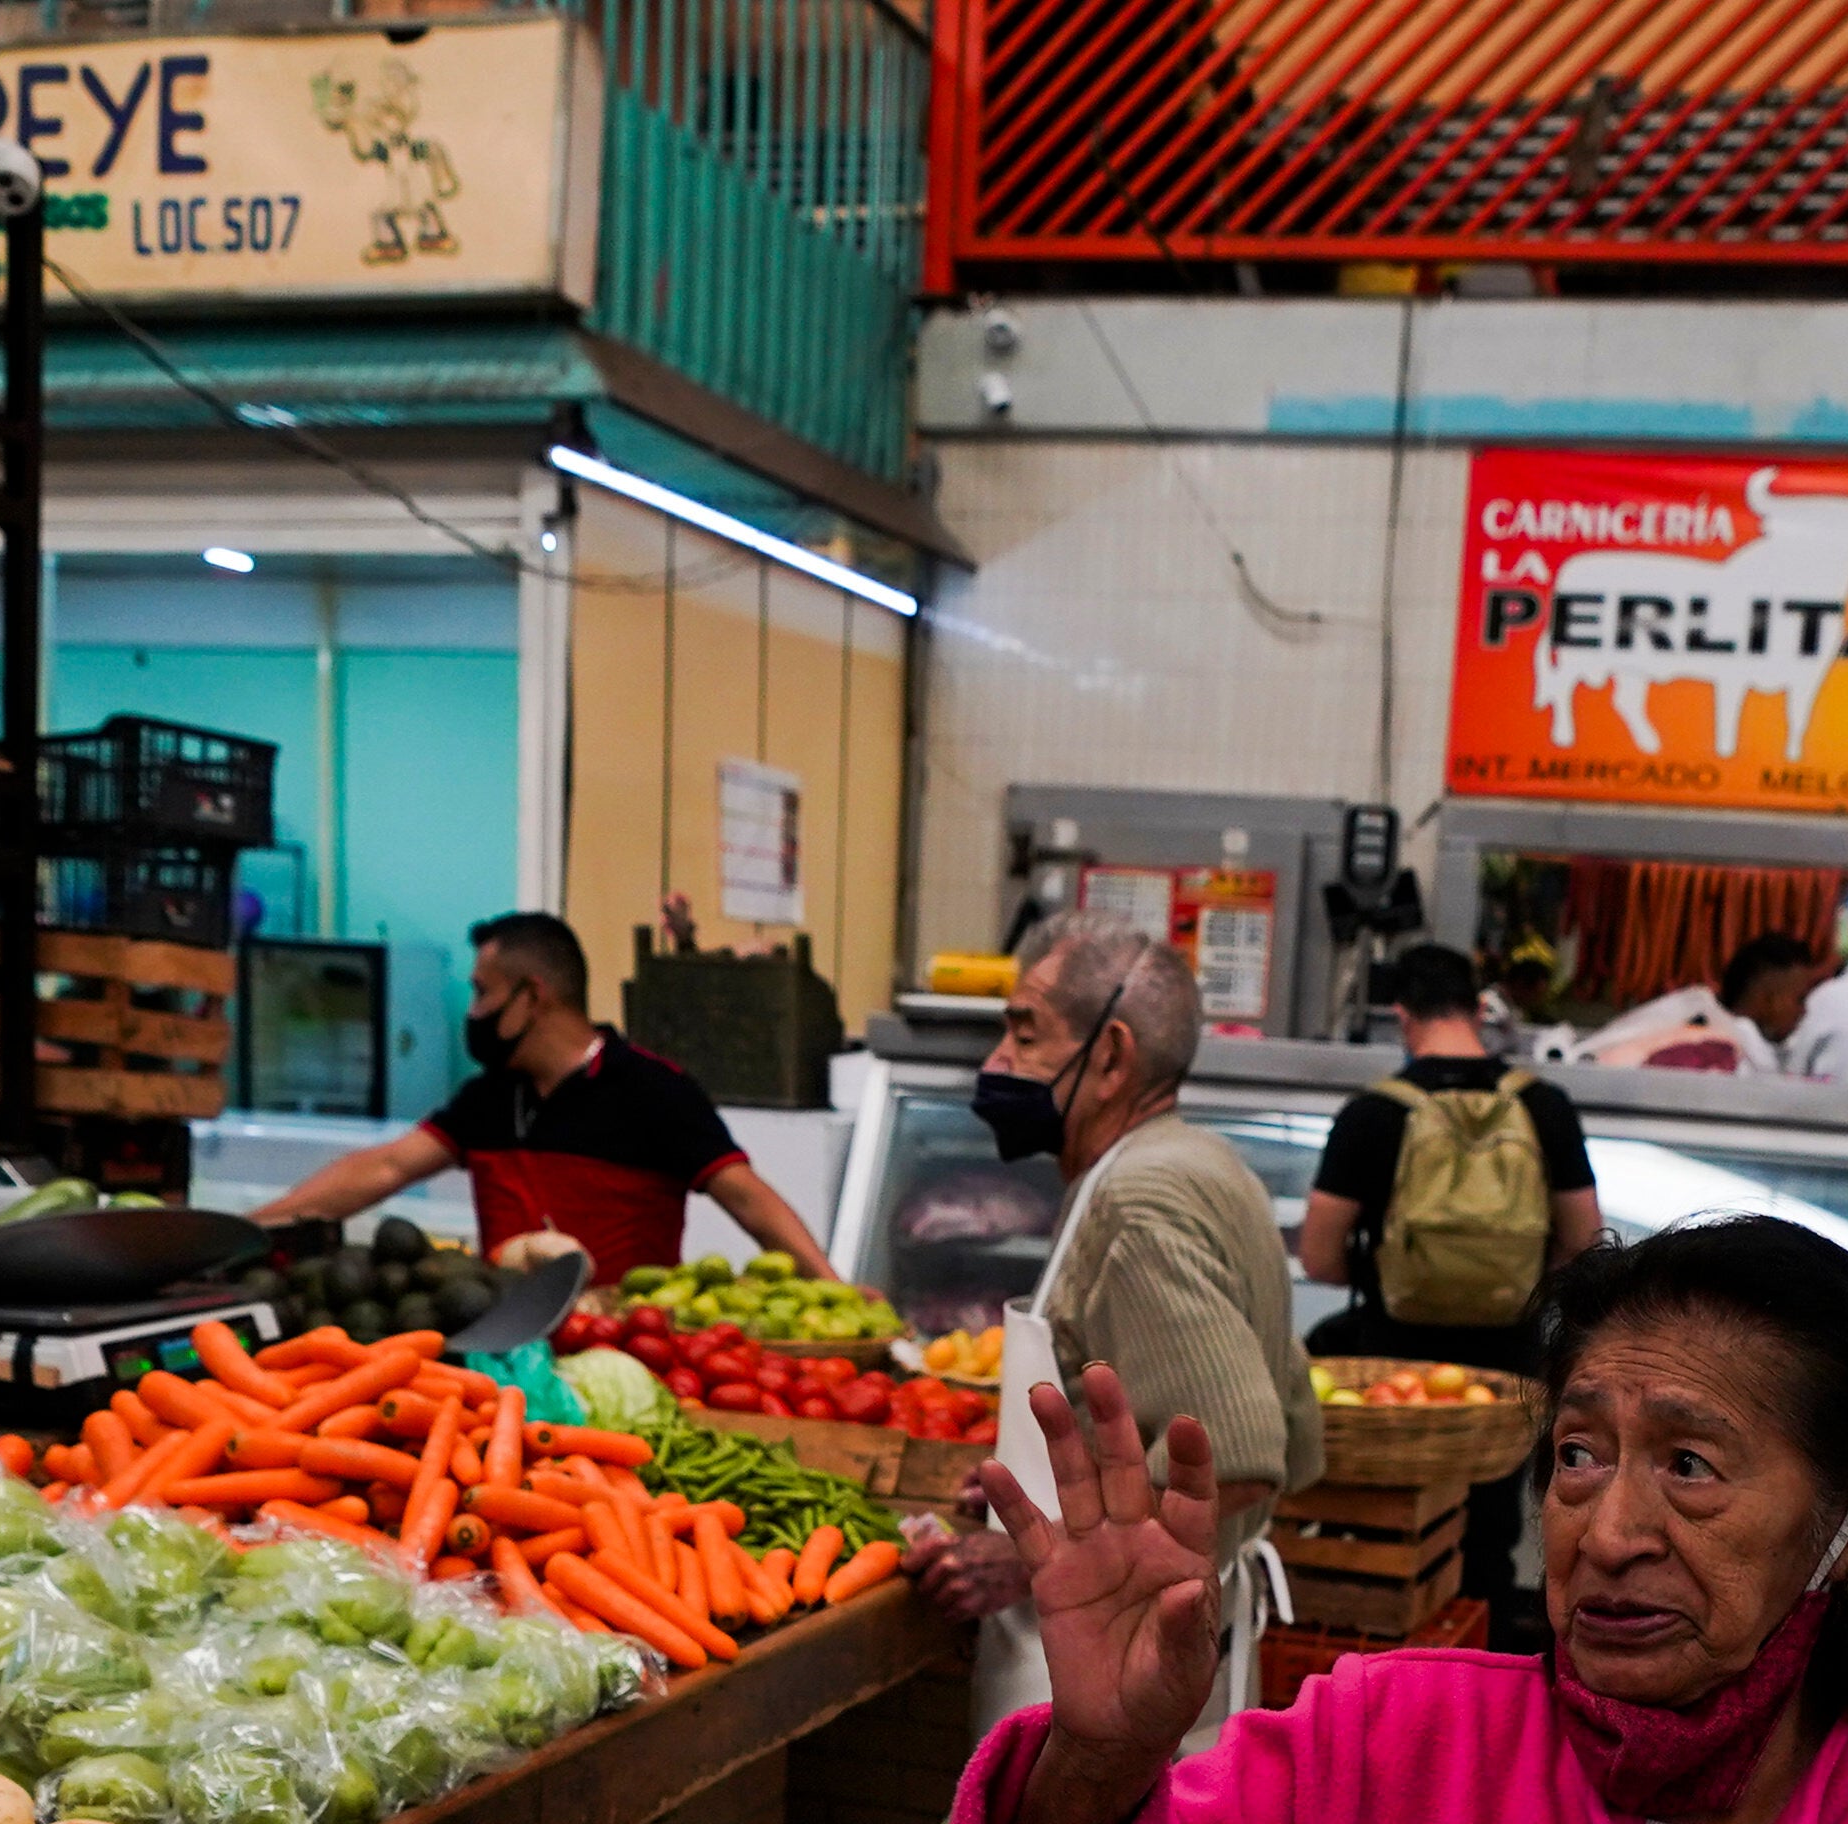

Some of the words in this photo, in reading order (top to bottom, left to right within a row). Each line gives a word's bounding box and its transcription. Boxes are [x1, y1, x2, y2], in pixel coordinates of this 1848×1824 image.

[1481, 492, 1735, 545] CARNICERÍA
[1480, 549, 1550, 585] LA
[1527, 757, 1721, 791] MERCADO
